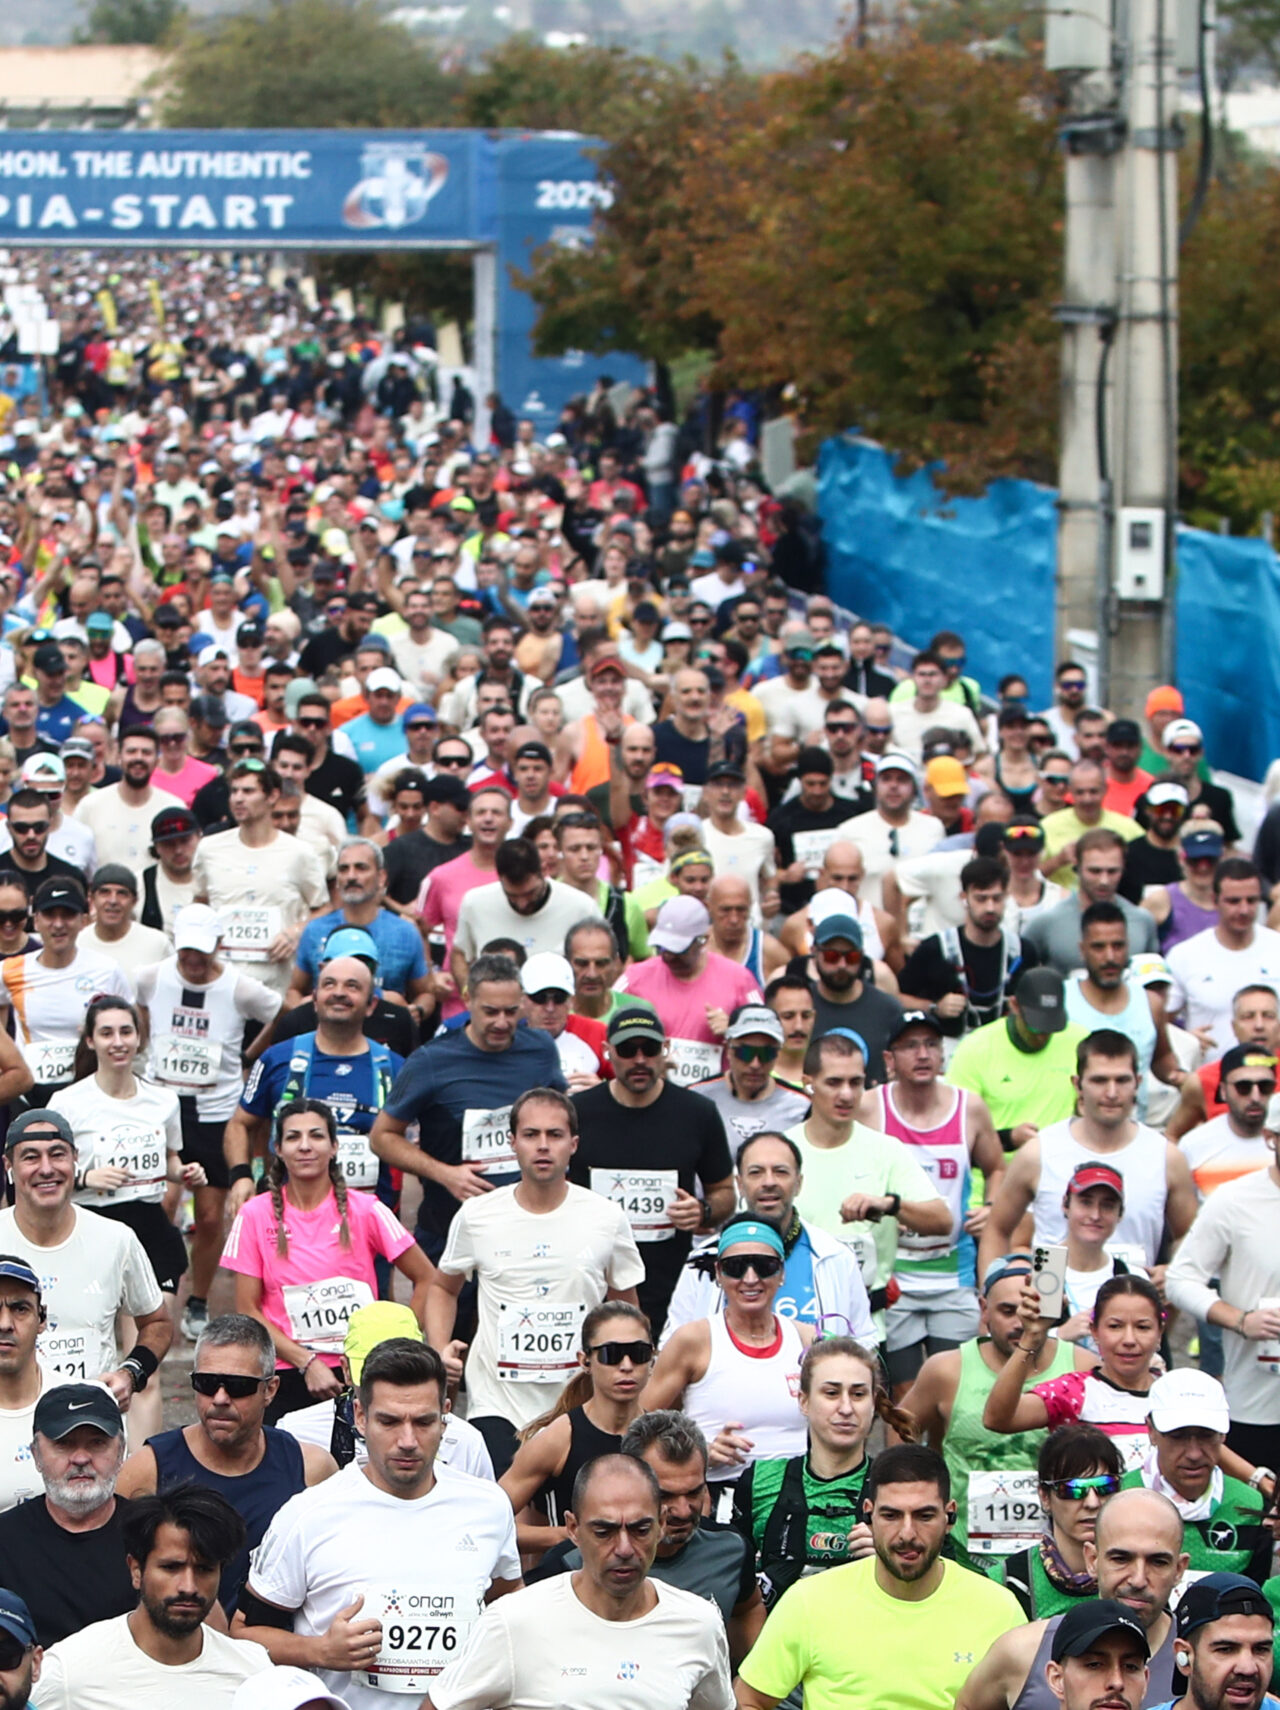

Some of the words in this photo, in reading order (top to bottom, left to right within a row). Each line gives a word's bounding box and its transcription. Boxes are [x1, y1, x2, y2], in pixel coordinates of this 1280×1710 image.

[72, 151, 139, 178] THE
[140, 151, 310, 179] AUTHENTIC
[227, 926, 269, 940] 12621
[161, 1056, 210, 1076] 11678
[107, 1152, 160, 1170] 12189
[607, 1196, 665, 1214] 1439
[775, 1296, 818, 1321] 64
[510, 1332, 574, 1353] 12067
[387, 1625, 458, 1651] 9276
